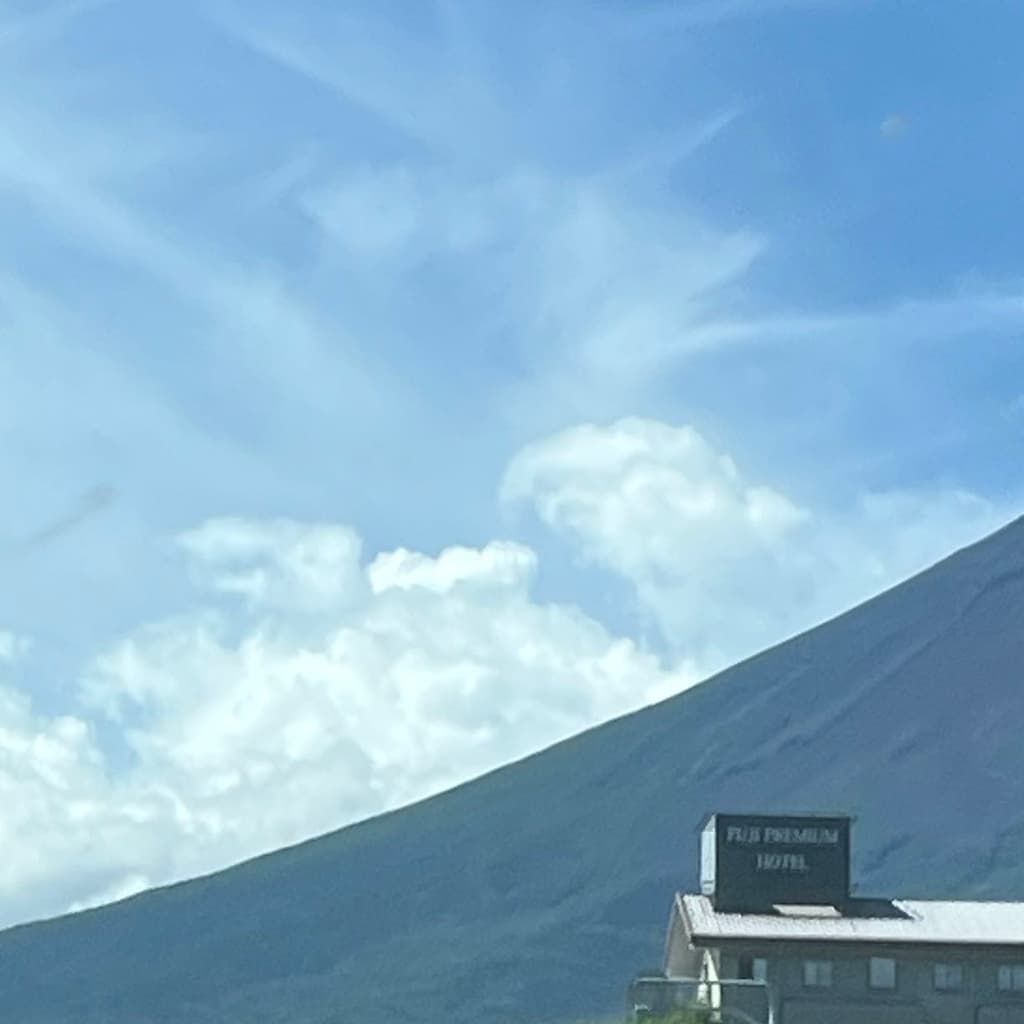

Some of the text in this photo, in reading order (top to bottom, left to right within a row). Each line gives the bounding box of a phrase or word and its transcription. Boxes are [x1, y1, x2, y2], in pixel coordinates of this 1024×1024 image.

[726, 827, 839, 843] FUJI PREMIUM
[757, 854, 809, 870] HOTEL
